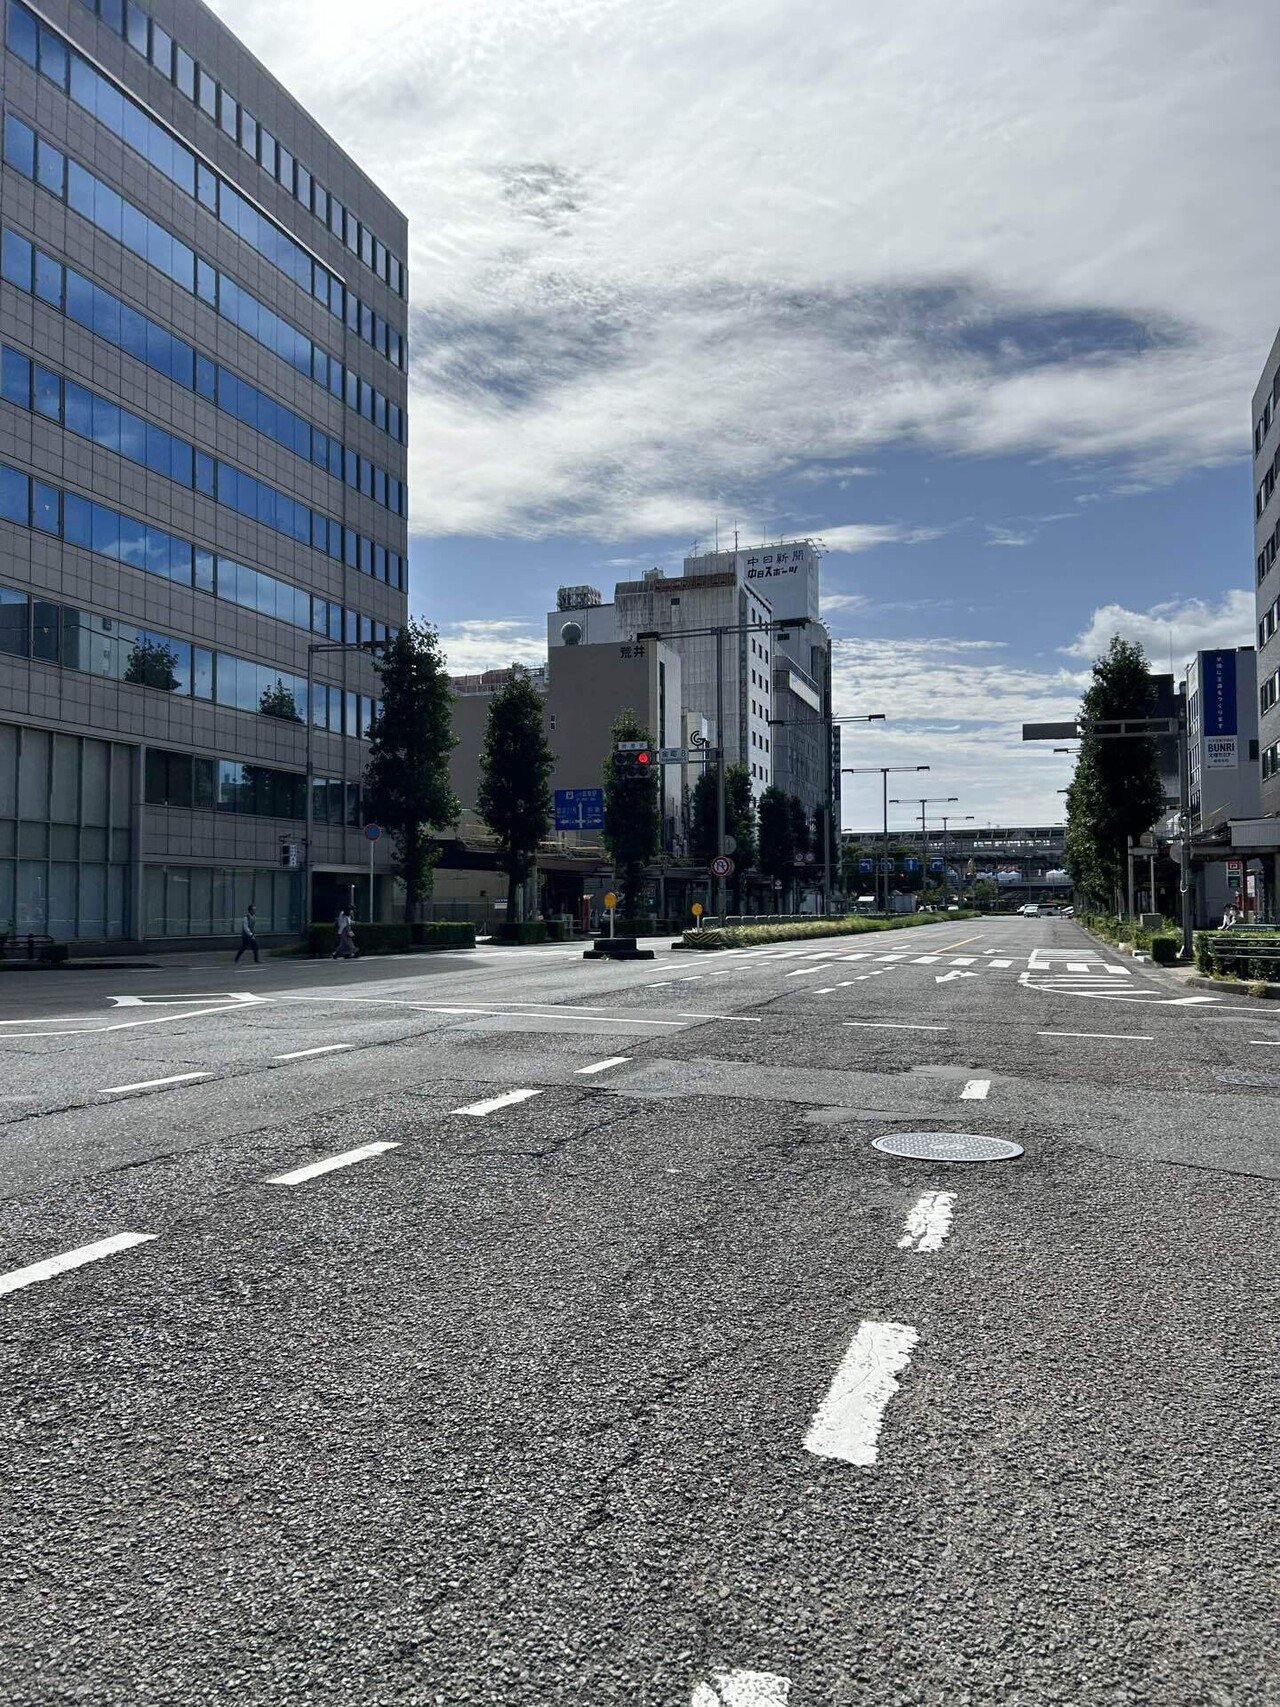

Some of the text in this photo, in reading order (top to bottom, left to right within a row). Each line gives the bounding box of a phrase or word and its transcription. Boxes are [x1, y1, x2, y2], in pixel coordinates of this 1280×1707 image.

[747, 550, 804, 567] 中日新聞
[747, 566, 798, 578] 中日スポーツ
[620, 645, 646, 658] 荒井
[1208, 743, 1235, 752] BUNRI
